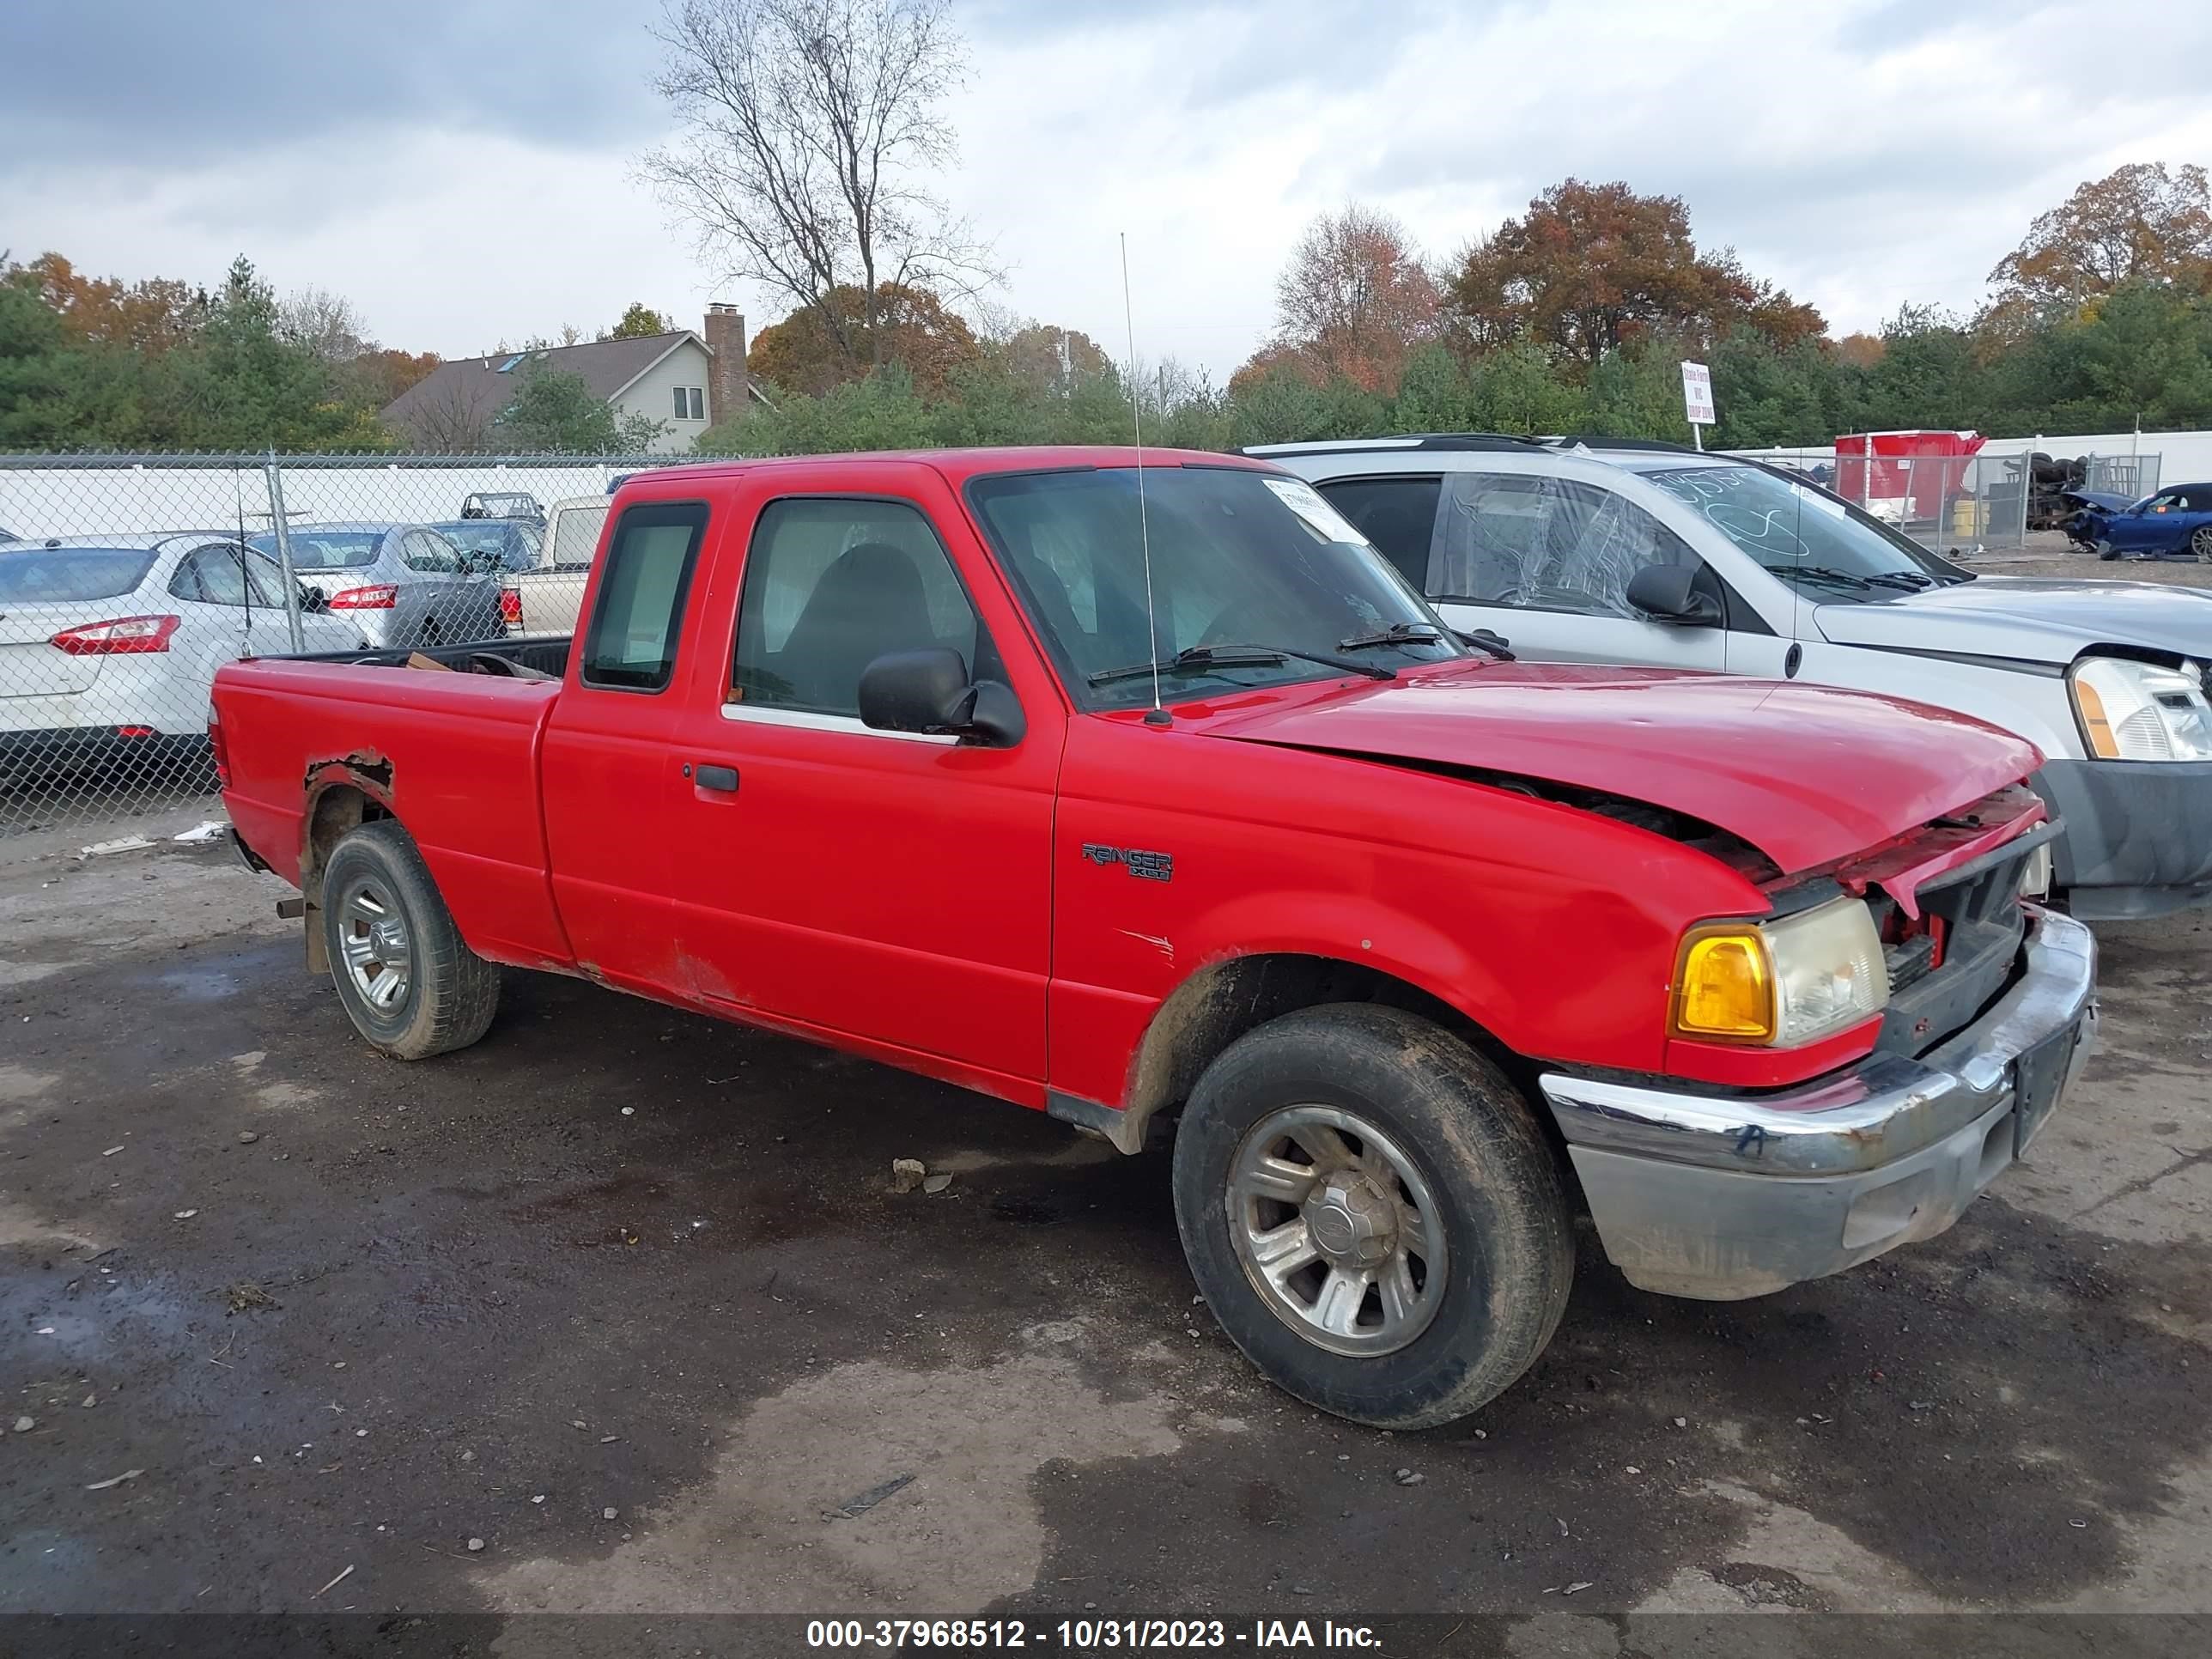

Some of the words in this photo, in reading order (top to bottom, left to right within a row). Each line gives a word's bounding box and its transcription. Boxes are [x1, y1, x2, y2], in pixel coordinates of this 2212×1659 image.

[1684, 368, 1697, 381] State
[1697, 369, 1709, 383] Farm
[1689, 405, 1701, 418] DROP
[1702, 406, 1713, 420] ZONE
[1082, 843, 1173, 871] RANGER
